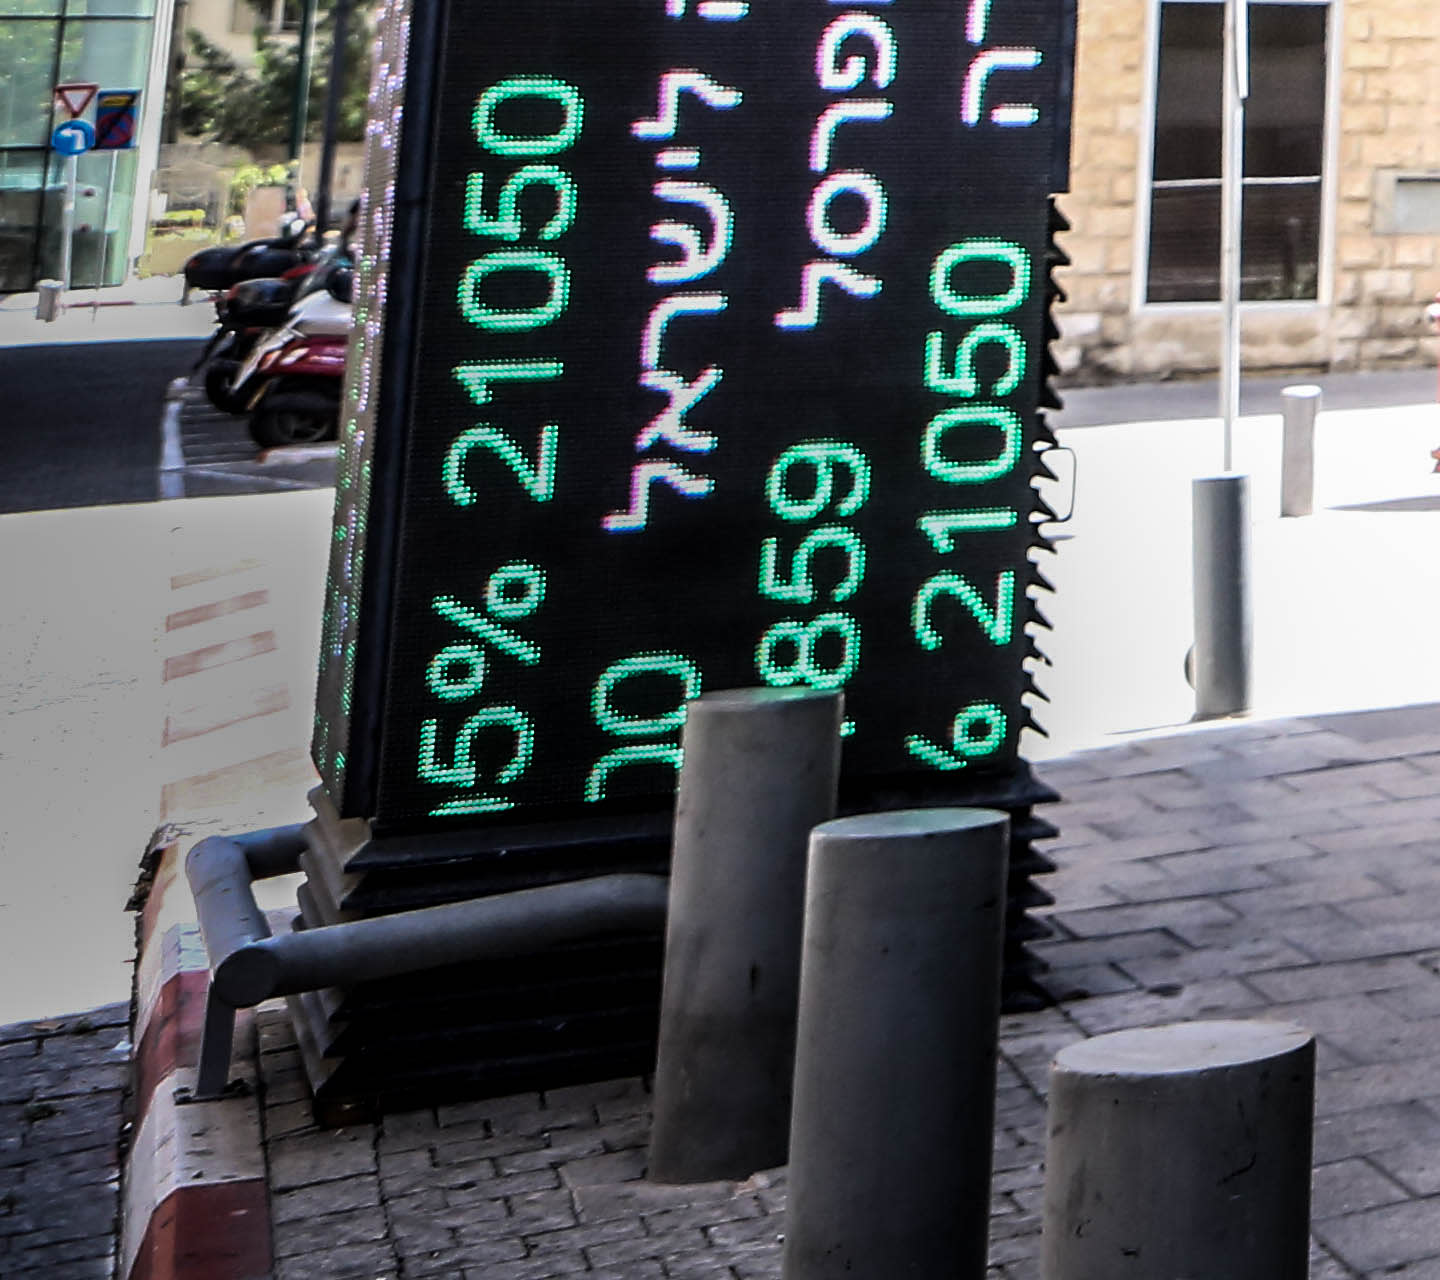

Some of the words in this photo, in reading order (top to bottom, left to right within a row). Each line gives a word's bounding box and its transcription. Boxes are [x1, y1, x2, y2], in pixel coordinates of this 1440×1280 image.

[442, 75, 584, 506] 21050
[603, 68, 742, 532] לישראל
[911, 237, 1031, 650] 21050
[418, 559, 546, 816] 5%
[754, 438, 872, 737] 859
